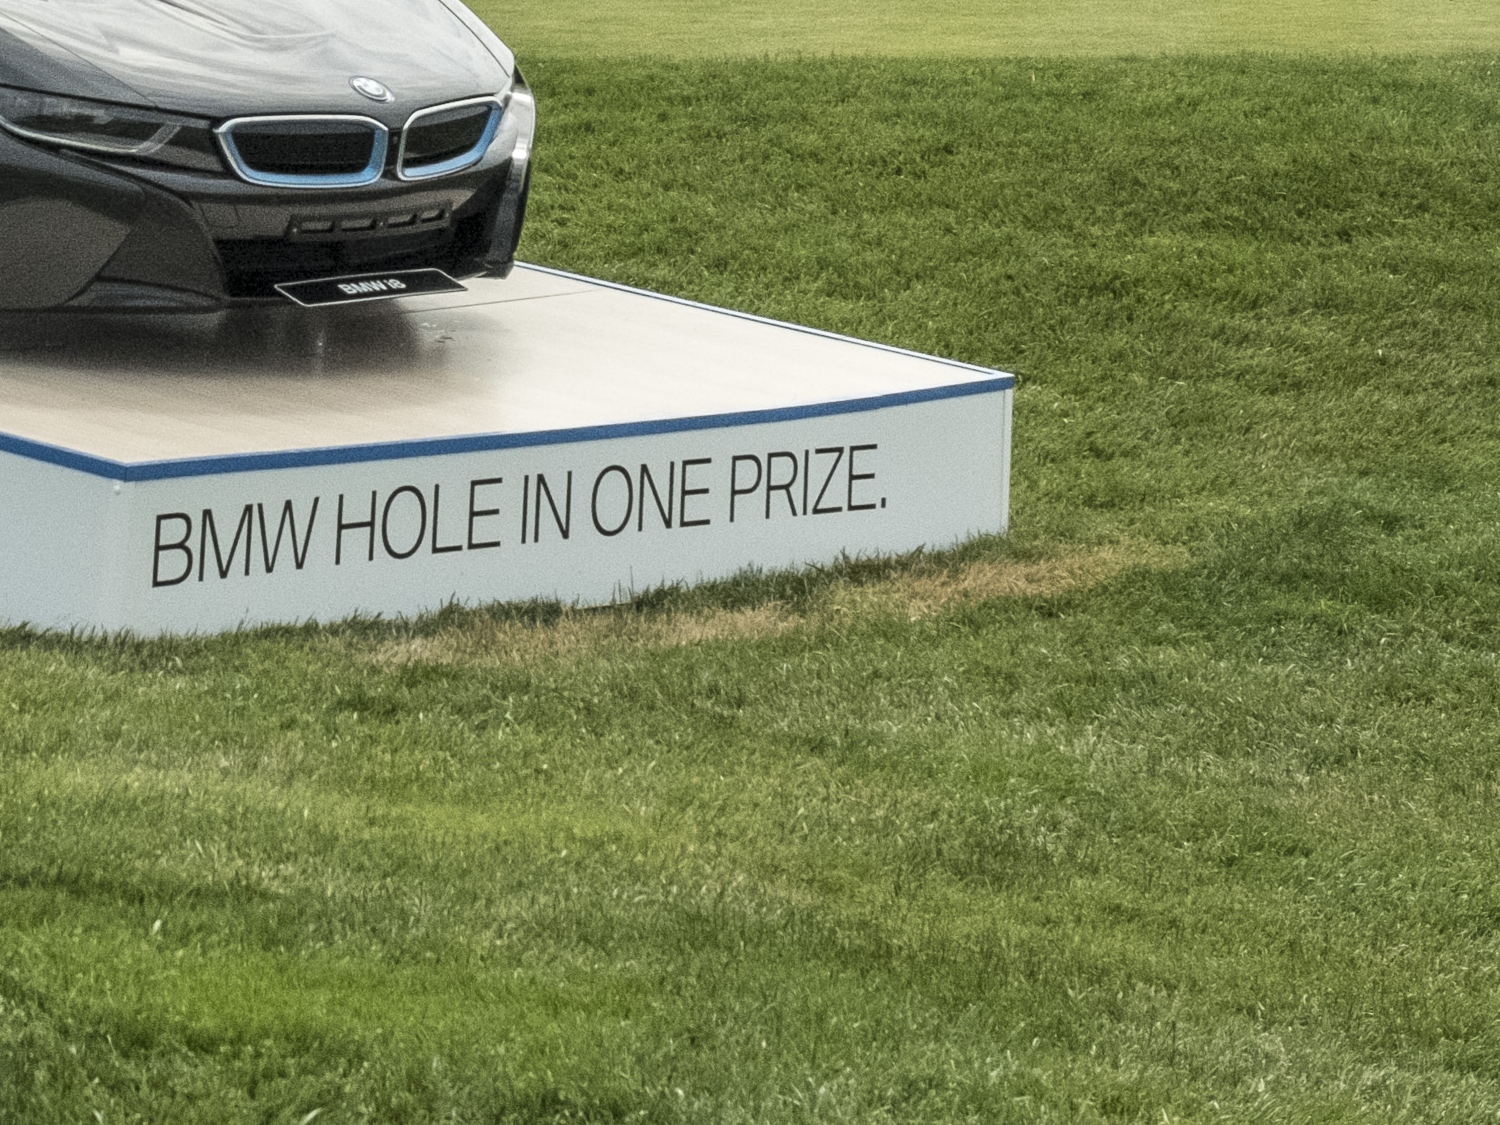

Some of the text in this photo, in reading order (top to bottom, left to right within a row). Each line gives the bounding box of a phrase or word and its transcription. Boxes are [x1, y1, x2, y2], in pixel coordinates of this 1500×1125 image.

[337, 278, 407, 295] BMW i8
[151, 443, 888, 589] BMW HOLE IN ONE PRIZE.
